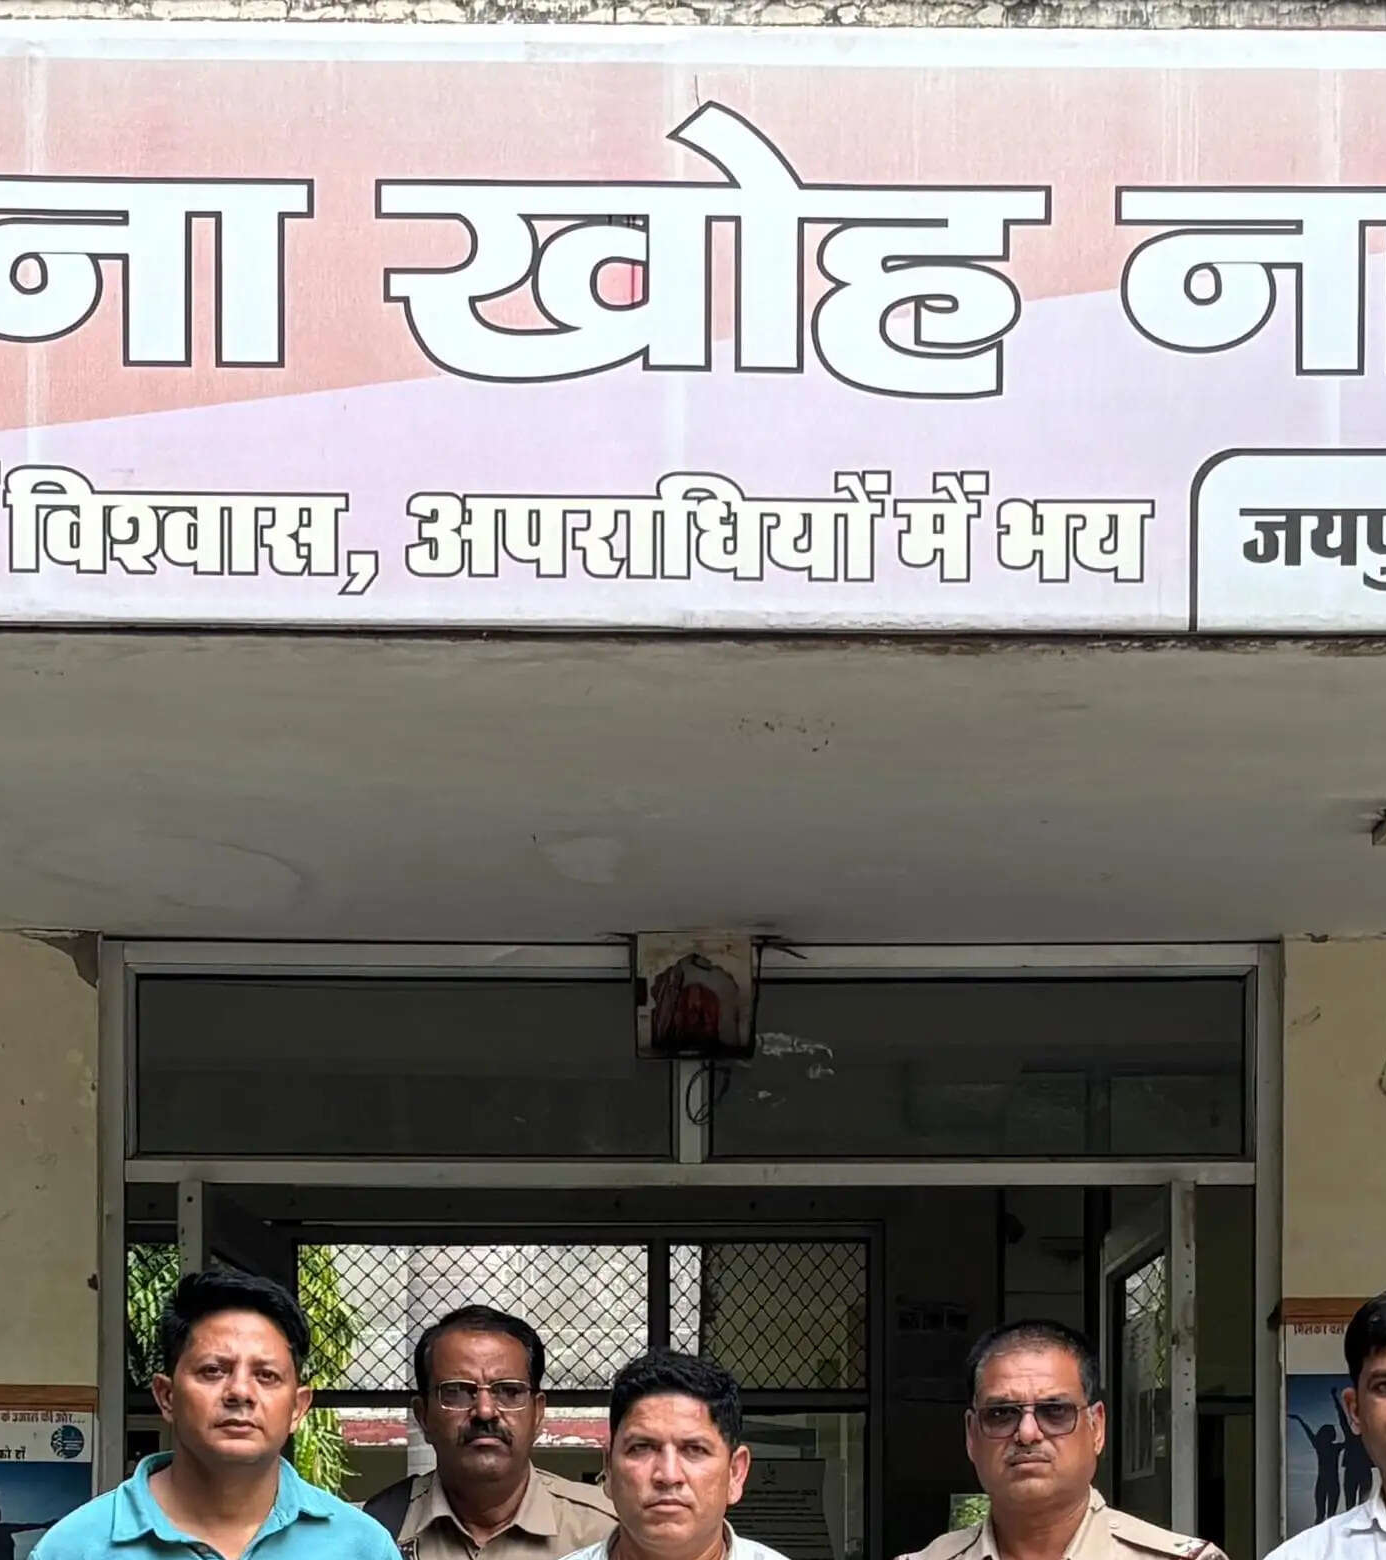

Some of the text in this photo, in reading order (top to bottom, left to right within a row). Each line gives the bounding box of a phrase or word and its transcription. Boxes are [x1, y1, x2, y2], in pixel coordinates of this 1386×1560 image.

[374, 99, 1052, 400] खोह
[5, 464, 379, 596] विश्वास,
[406, 470, 891, 583] अपराधियों
[895, 470, 989, 584] में
[997, 497, 1154, 584] भय
